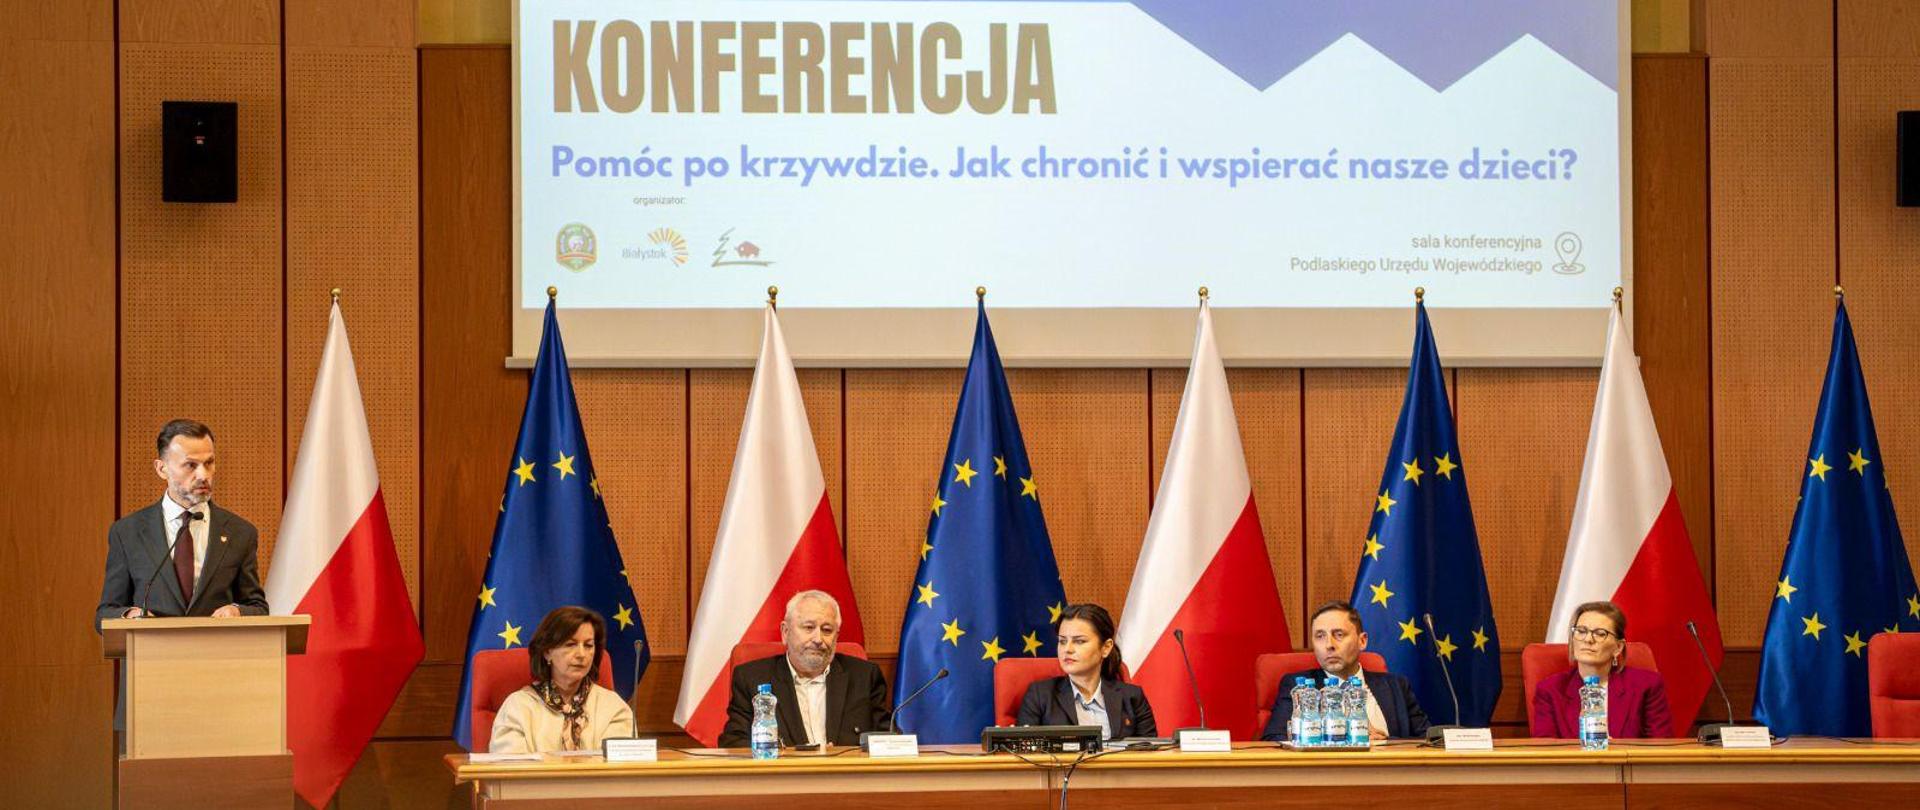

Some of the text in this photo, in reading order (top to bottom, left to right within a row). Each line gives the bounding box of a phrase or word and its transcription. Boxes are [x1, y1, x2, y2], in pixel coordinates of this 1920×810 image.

[551, 19, 1058, 115] KONFERENCJA
[551, 145, 1579, 187] Pomóc po krzywdzie. Jak chronić i wspierać nasze dzieci?
[1411, 234, 1542, 253] sala konferencyjna
[621, 247, 667, 261] Białystok
[1290, 256, 1543, 275] Podlaskiego Urzędu Wojewódzkiego
